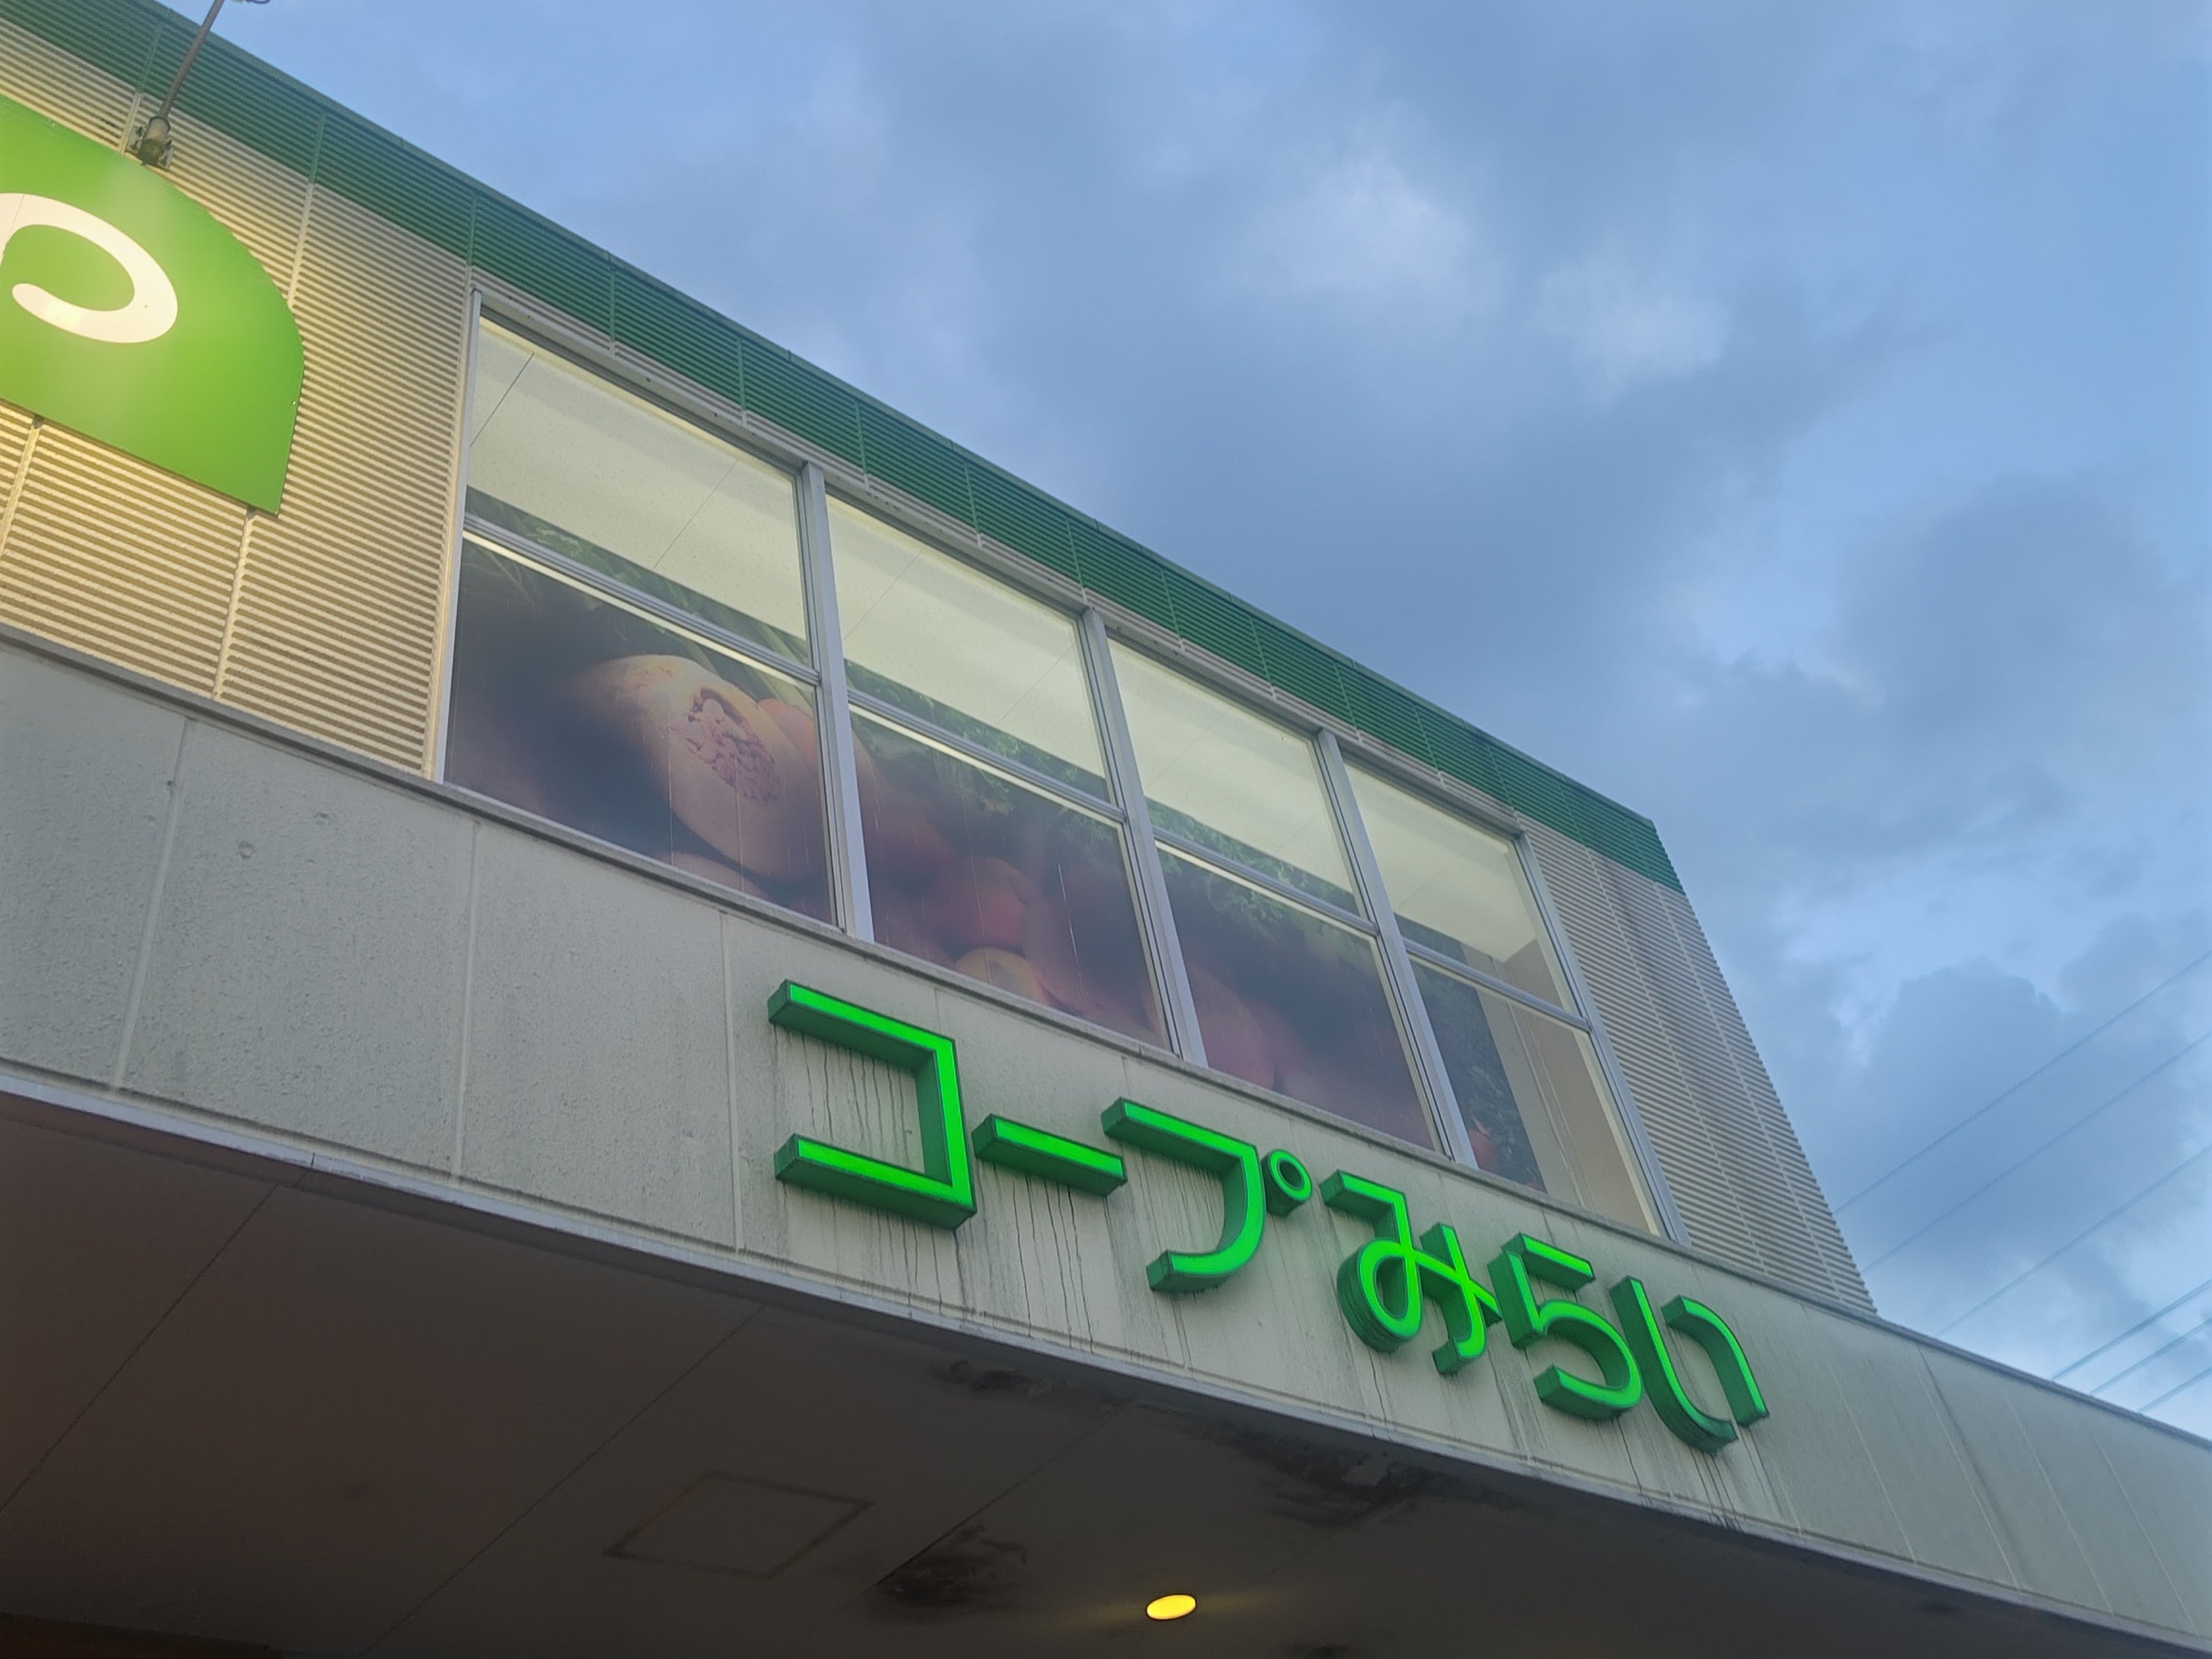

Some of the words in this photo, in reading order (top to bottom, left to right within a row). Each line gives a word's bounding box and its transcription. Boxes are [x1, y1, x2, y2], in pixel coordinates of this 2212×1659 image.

[769, 980, 1768, 1452] コープみらい
